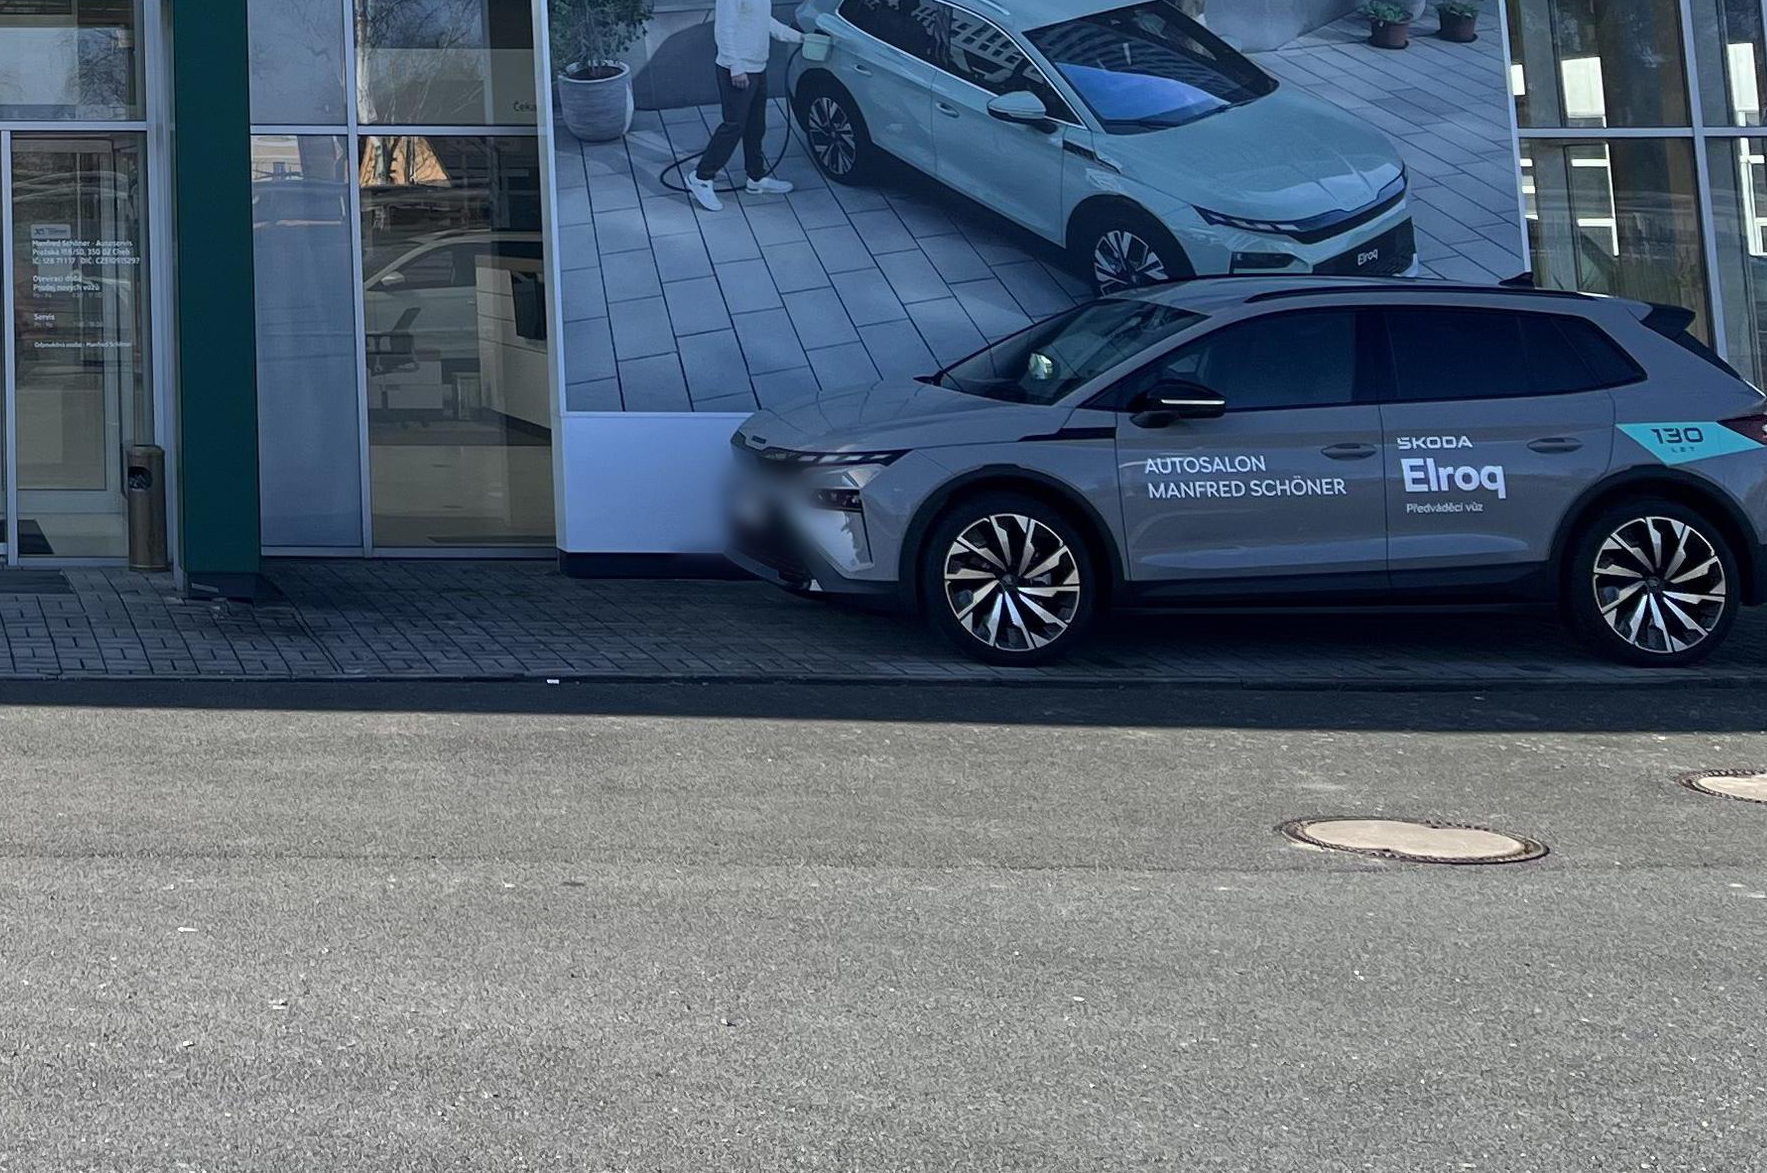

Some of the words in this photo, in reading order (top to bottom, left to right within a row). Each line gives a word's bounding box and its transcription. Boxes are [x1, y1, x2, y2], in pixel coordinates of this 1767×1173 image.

[1357, 248, 1379, 267] Elroq
[1651, 426, 1705, 445] 130
[1144, 455, 1267, 475] AUTOSALON
[1147, 480, 1247, 500] MANFRED
[1249, 475, 1348, 497] SCHÖNER
[1400, 457, 1508, 500] Elroq
[1406, 500, 1463, 514] Předváděcí
[1464, 501, 1484, 514] vůz
